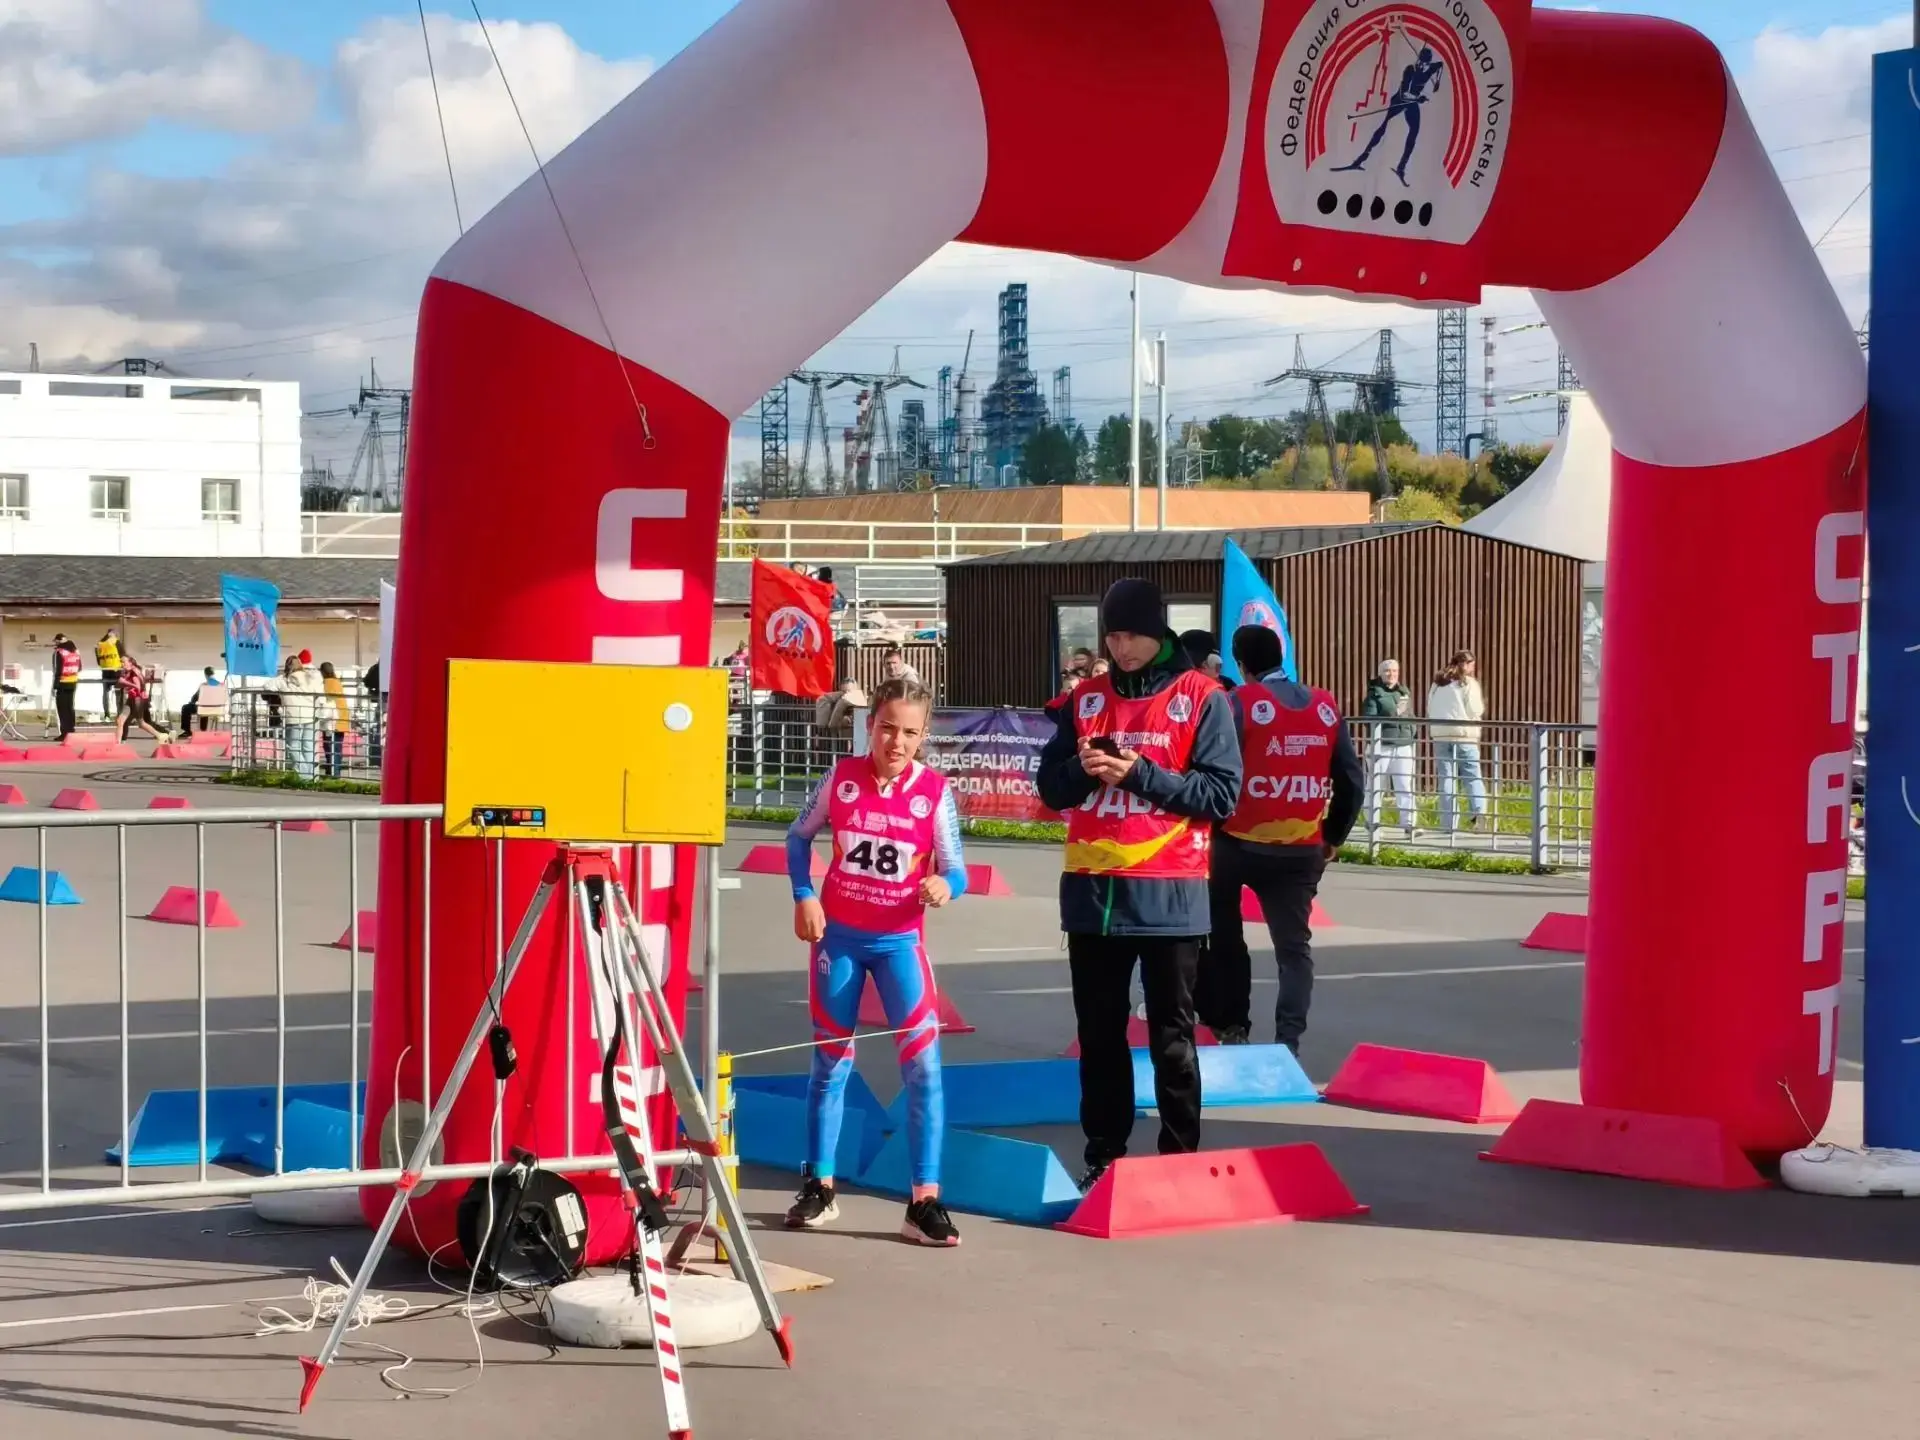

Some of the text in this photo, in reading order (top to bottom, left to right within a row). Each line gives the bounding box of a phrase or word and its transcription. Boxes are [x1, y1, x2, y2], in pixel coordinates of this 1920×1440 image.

[1280, 8, 1340, 156] Федерация
[1469, 83, 1505, 188] Москвы
[926, 752, 1026, 772] ФЕДЕРАЦИЯ
[948, 776, 1041, 796] РОДА МОСК
[1803, 511, 1863, 1076] СТАРТ
[846, 840, 899, 875] 48
